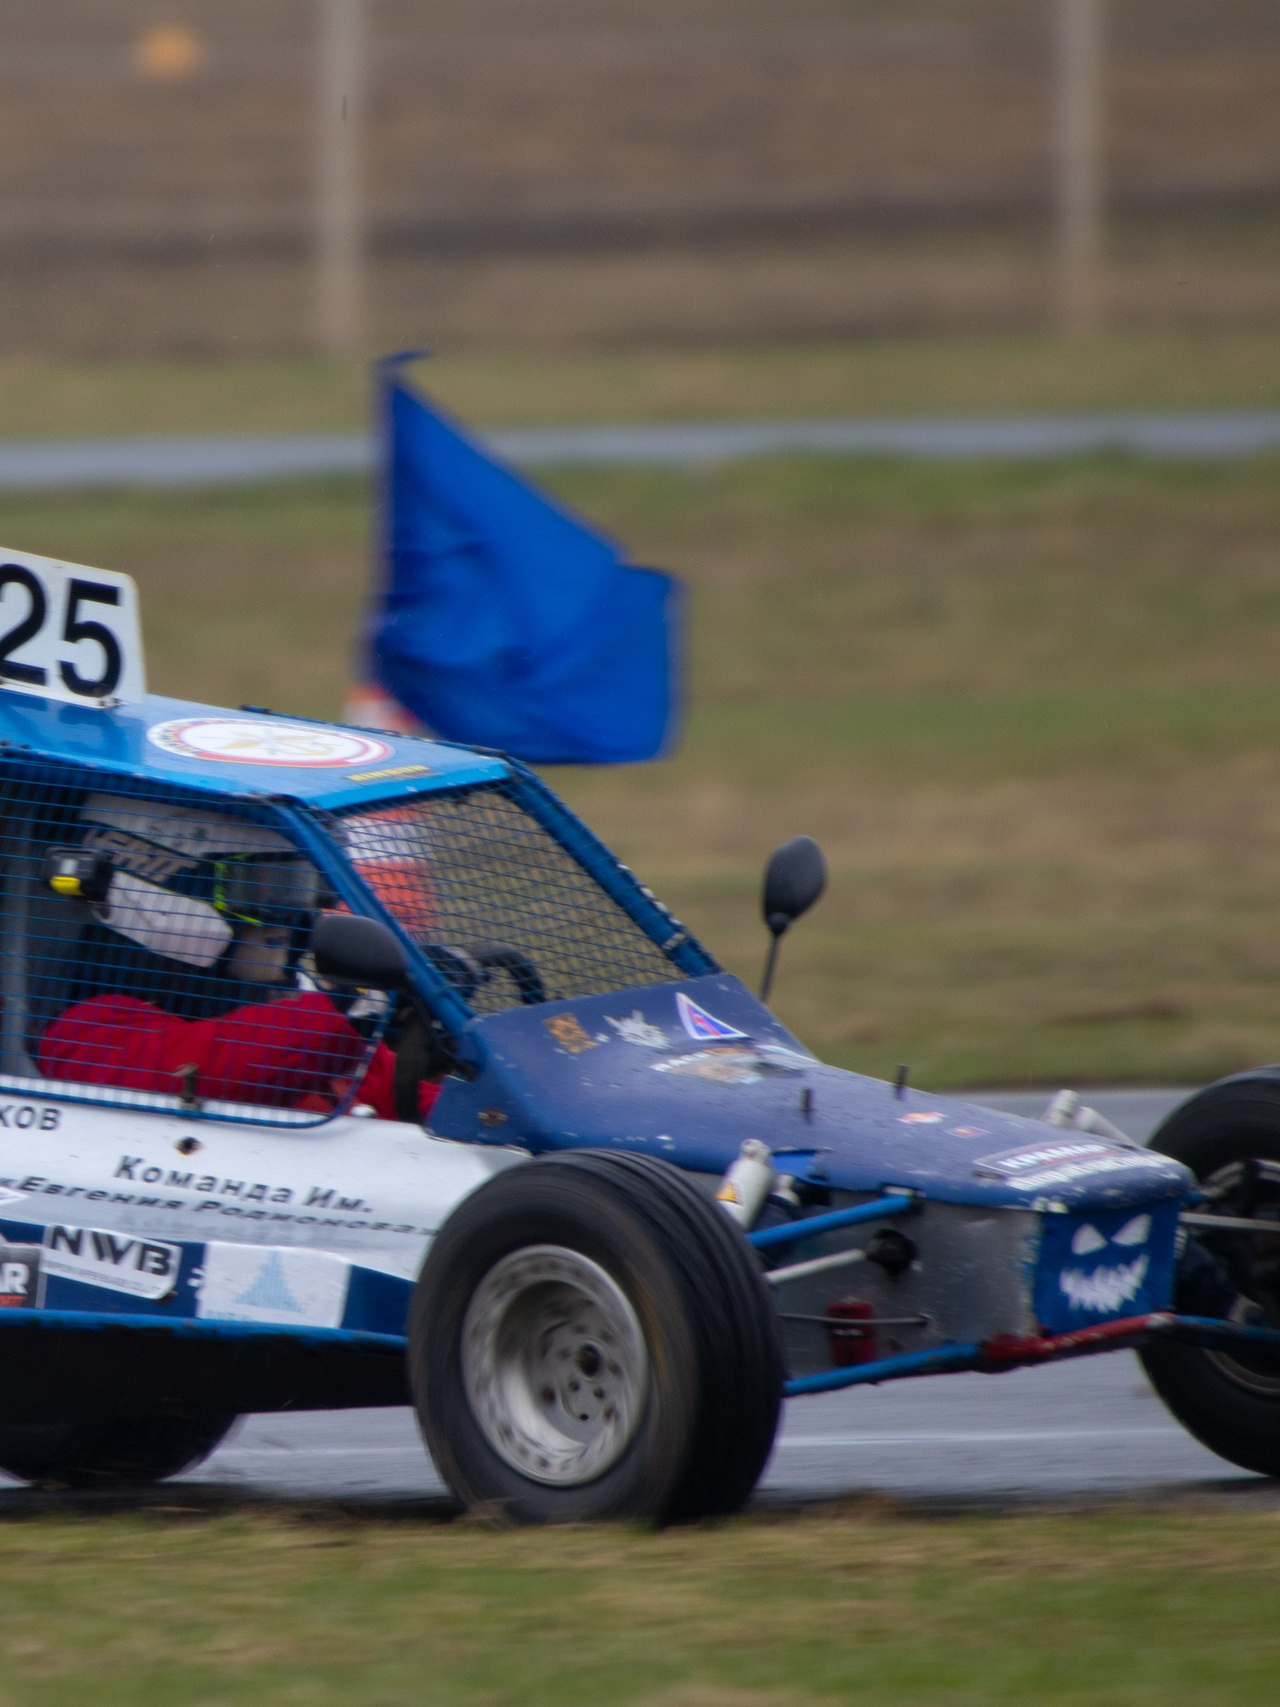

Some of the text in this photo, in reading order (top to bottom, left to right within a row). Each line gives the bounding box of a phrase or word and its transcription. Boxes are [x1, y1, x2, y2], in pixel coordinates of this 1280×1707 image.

[113, 1154, 374, 1214] Команда Им.
[50, 1224, 173, 1276] NWB
